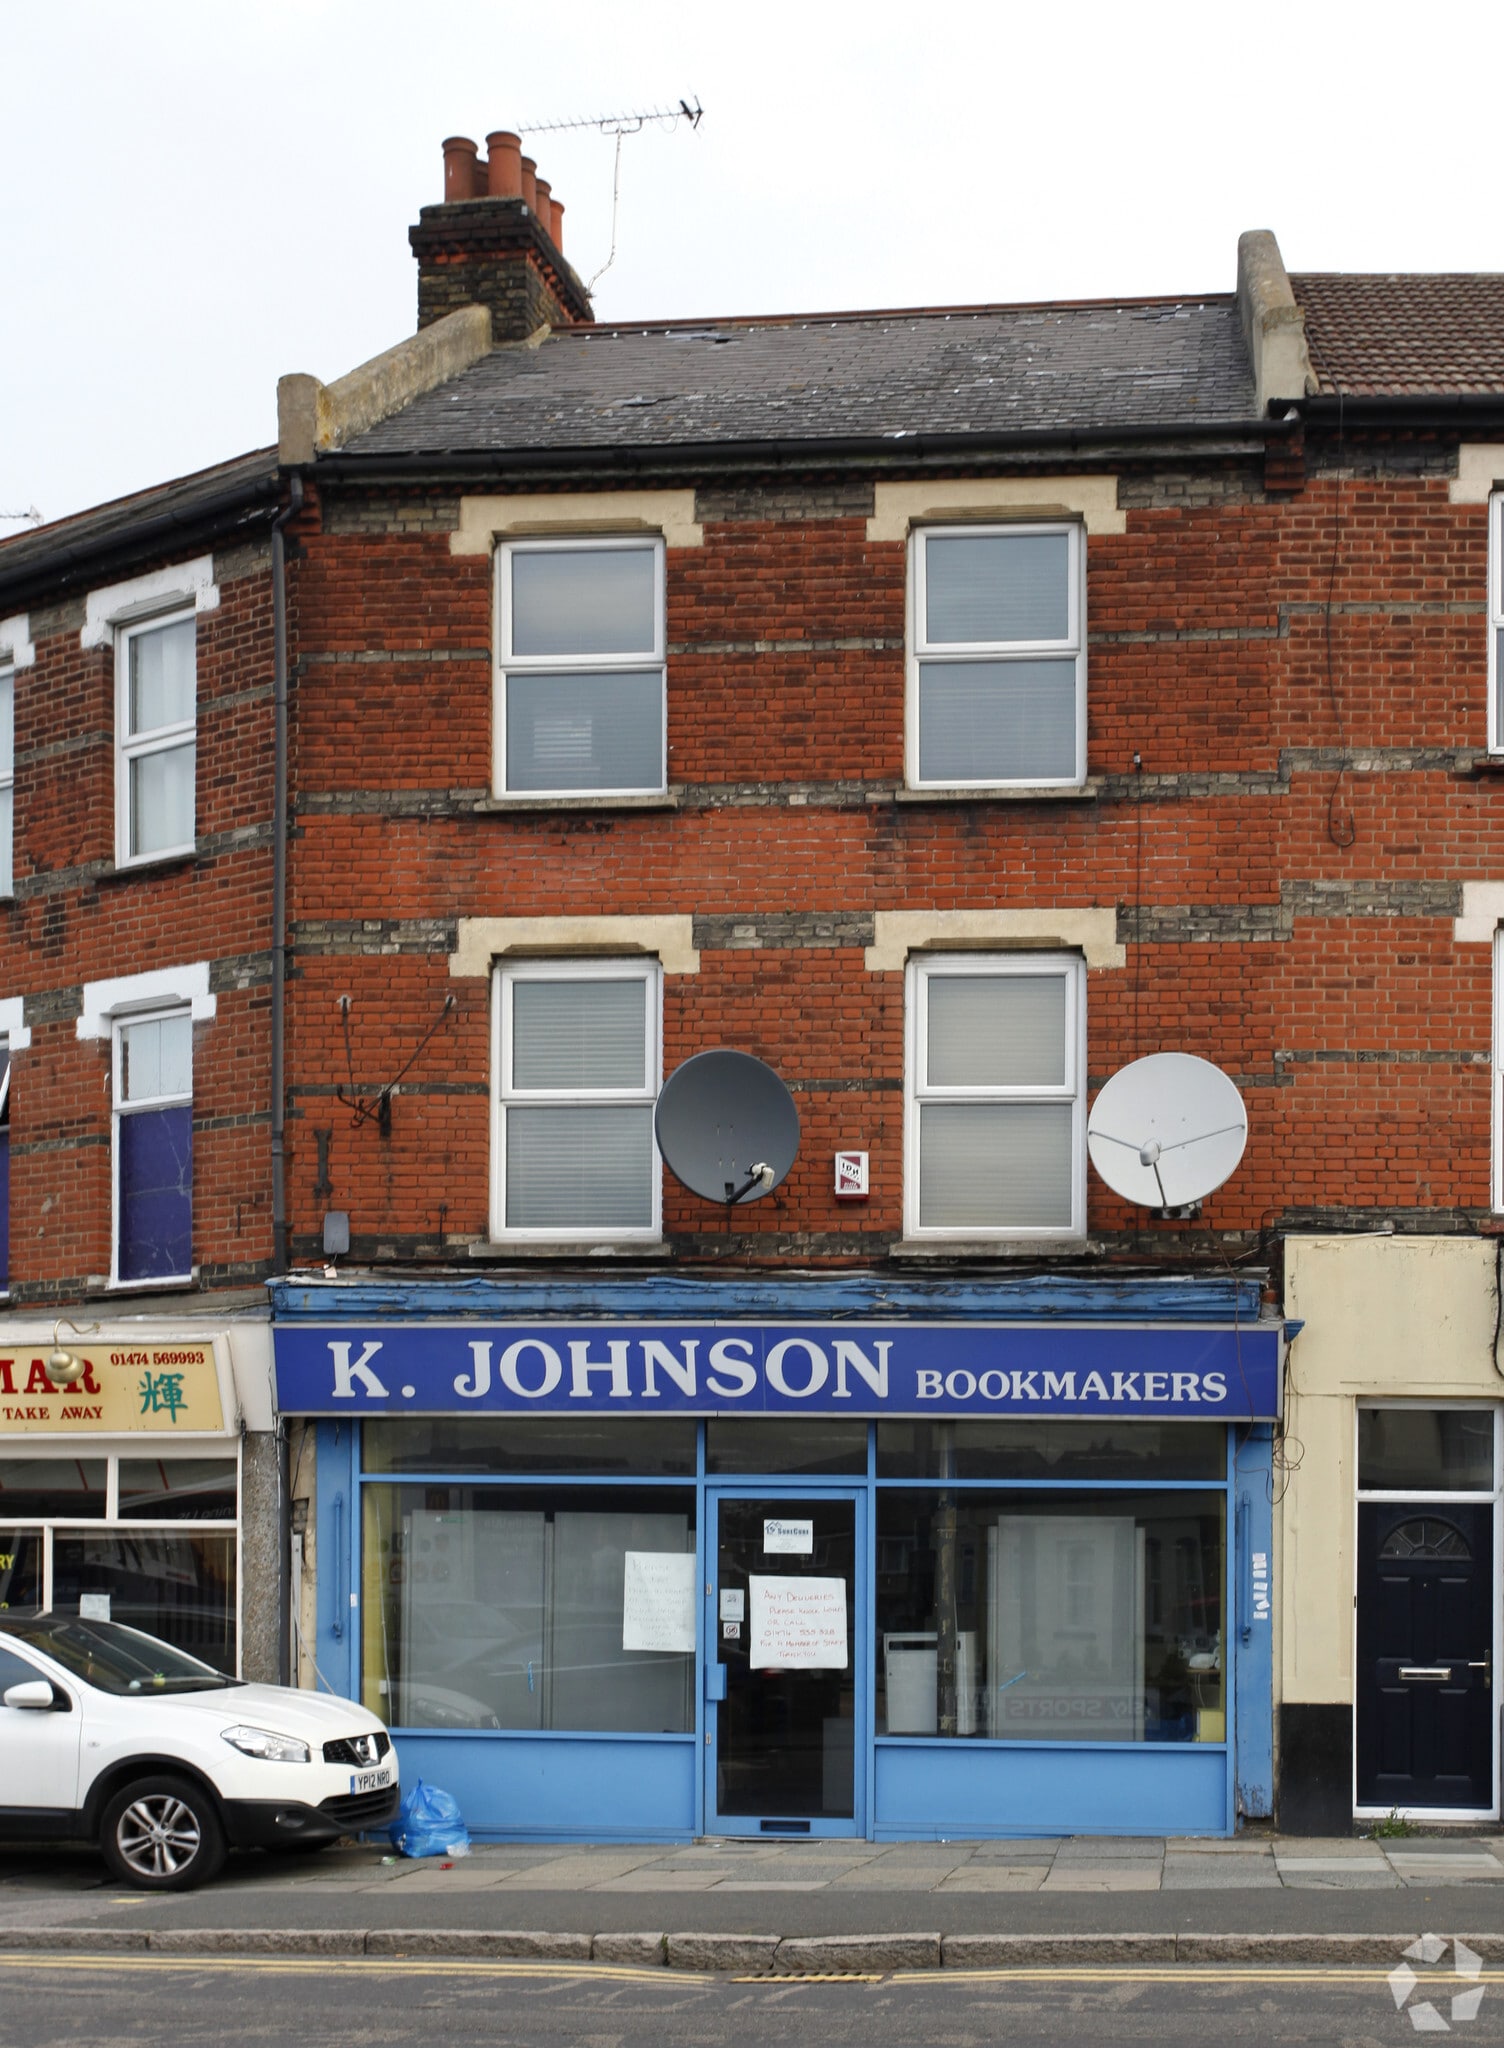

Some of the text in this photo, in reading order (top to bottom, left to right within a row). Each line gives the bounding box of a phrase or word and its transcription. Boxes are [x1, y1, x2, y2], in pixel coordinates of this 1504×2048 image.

[110, 1352, 205, 1366] 01474 569993
[328, 1338, 1228, 1402] K. JOHNSON BOOKMAKERS
[139, 1371, 188, 1424] 輝
[2, 1406, 103, 1420] TAKE AWAY
[358, 1774, 376, 1791] YP12
